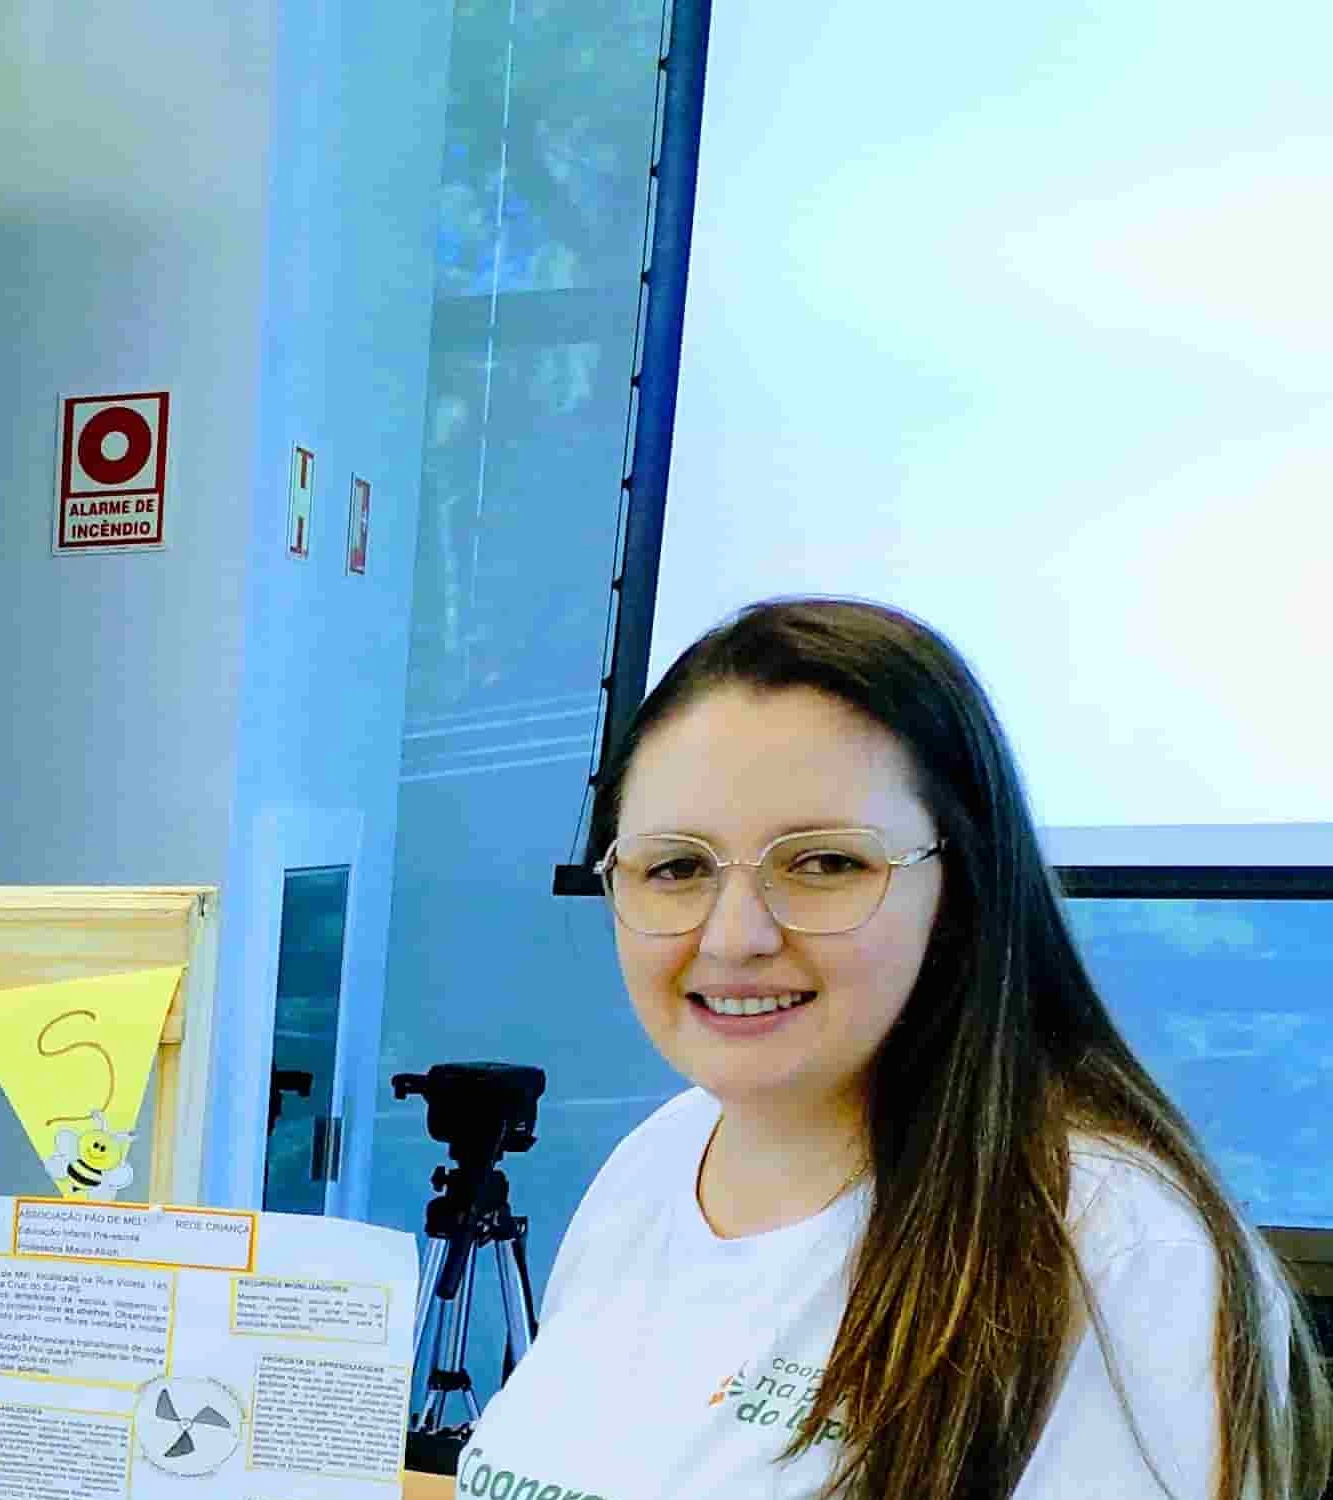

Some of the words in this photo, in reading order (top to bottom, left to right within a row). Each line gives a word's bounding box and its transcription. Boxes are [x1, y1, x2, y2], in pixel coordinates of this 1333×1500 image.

[69, 500, 130, 517] ALARME
[134, 498, 154, 514] DE
[71, 519, 151, 539] INCÊNDIO
[756, 1376, 796, 1398] na
[736, 1399, 780, 1425] do
